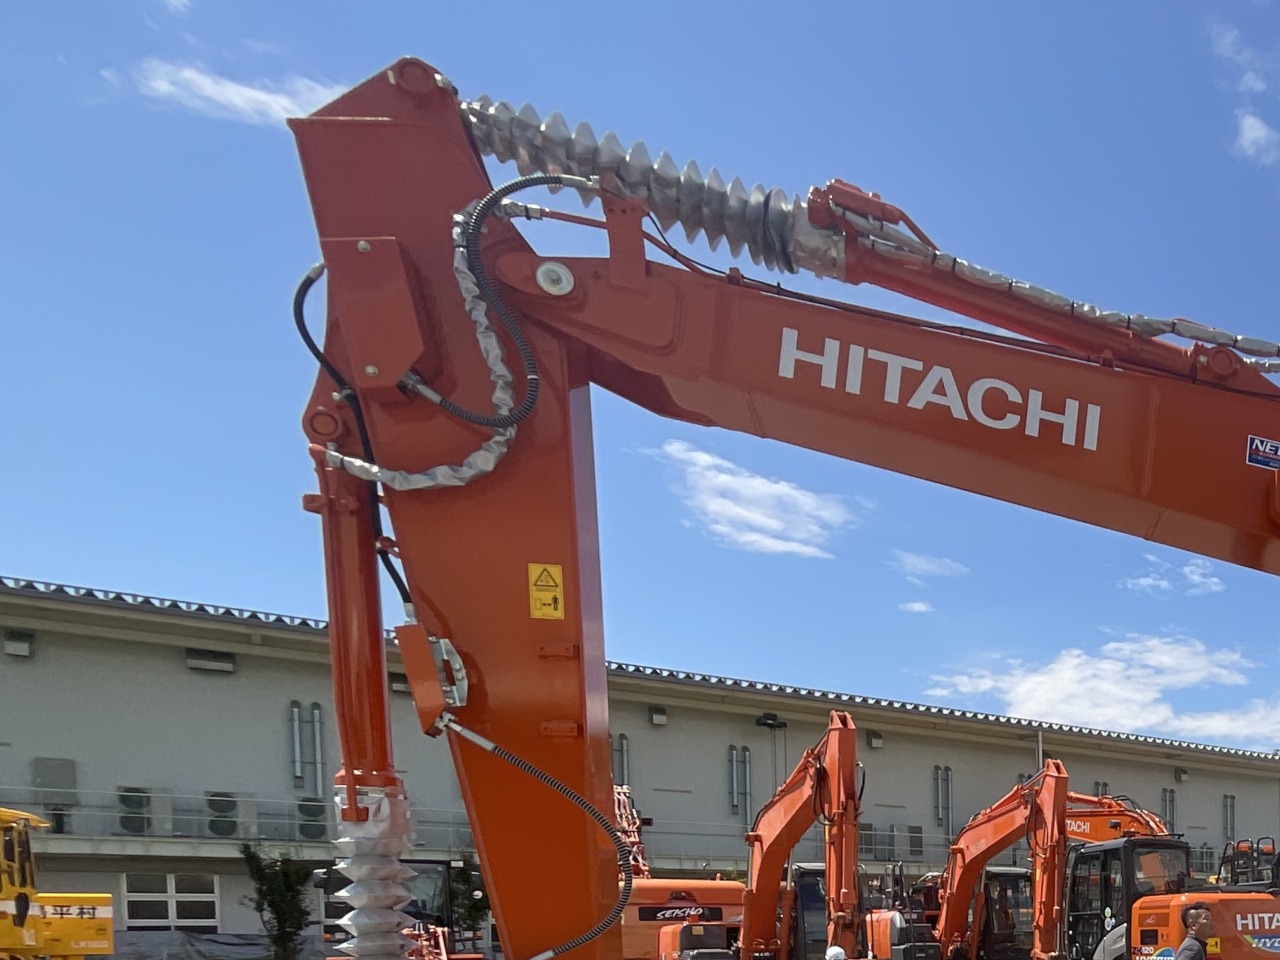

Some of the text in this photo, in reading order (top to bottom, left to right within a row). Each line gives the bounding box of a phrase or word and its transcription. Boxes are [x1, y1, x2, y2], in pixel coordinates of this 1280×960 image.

[778, 326, 1101, 451] HITACHI
[1065, 819, 1090, 833] TACHI
[656, 907, 703, 919] SEISHO
